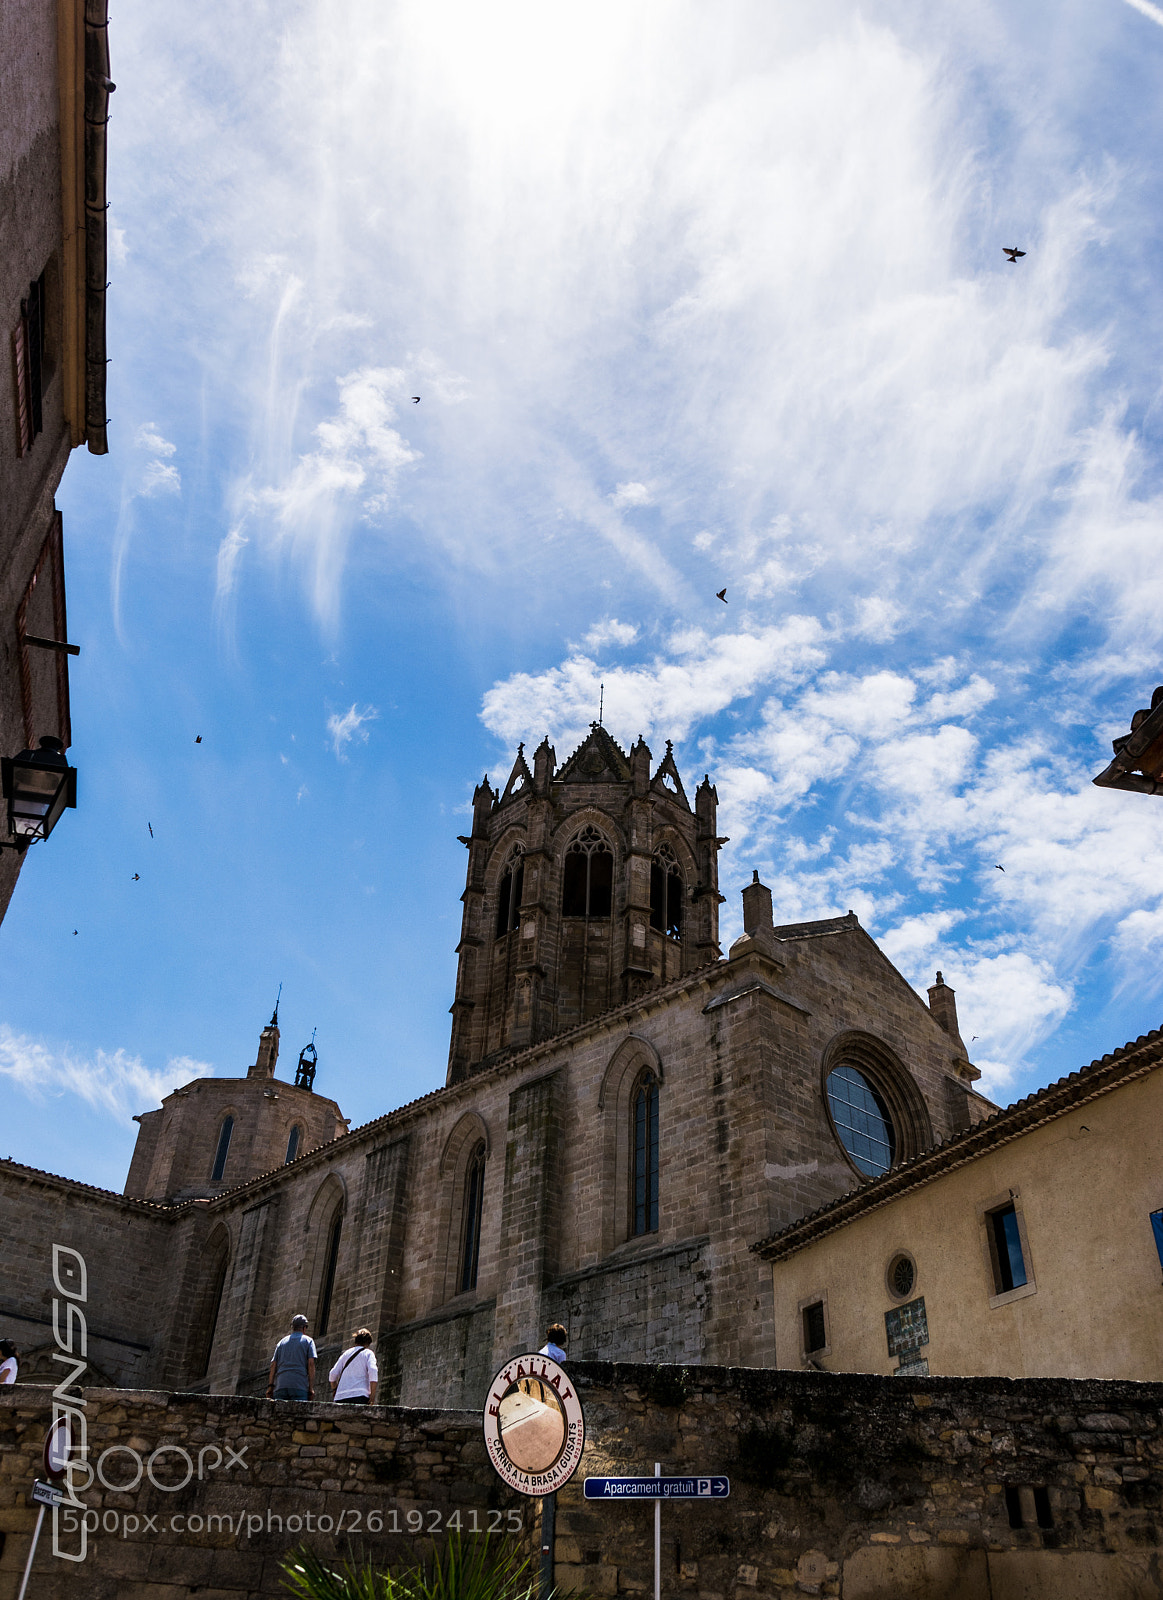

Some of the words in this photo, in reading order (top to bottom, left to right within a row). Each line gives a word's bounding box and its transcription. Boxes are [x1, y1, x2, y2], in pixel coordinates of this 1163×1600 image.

[502, 1361, 573, 1401] TALLAT
[493, 1438, 513, 1473] CARNS
[511, 1469, 518, 1480] A
[518, 1473, 529, 1486] LA
[531, 1469, 559, 1487] BRASA
[559, 1422, 577, 1468] GUISATS
[603, 1480, 661, 1497] Aparcament
[699, 1481, 709, 1494] P
